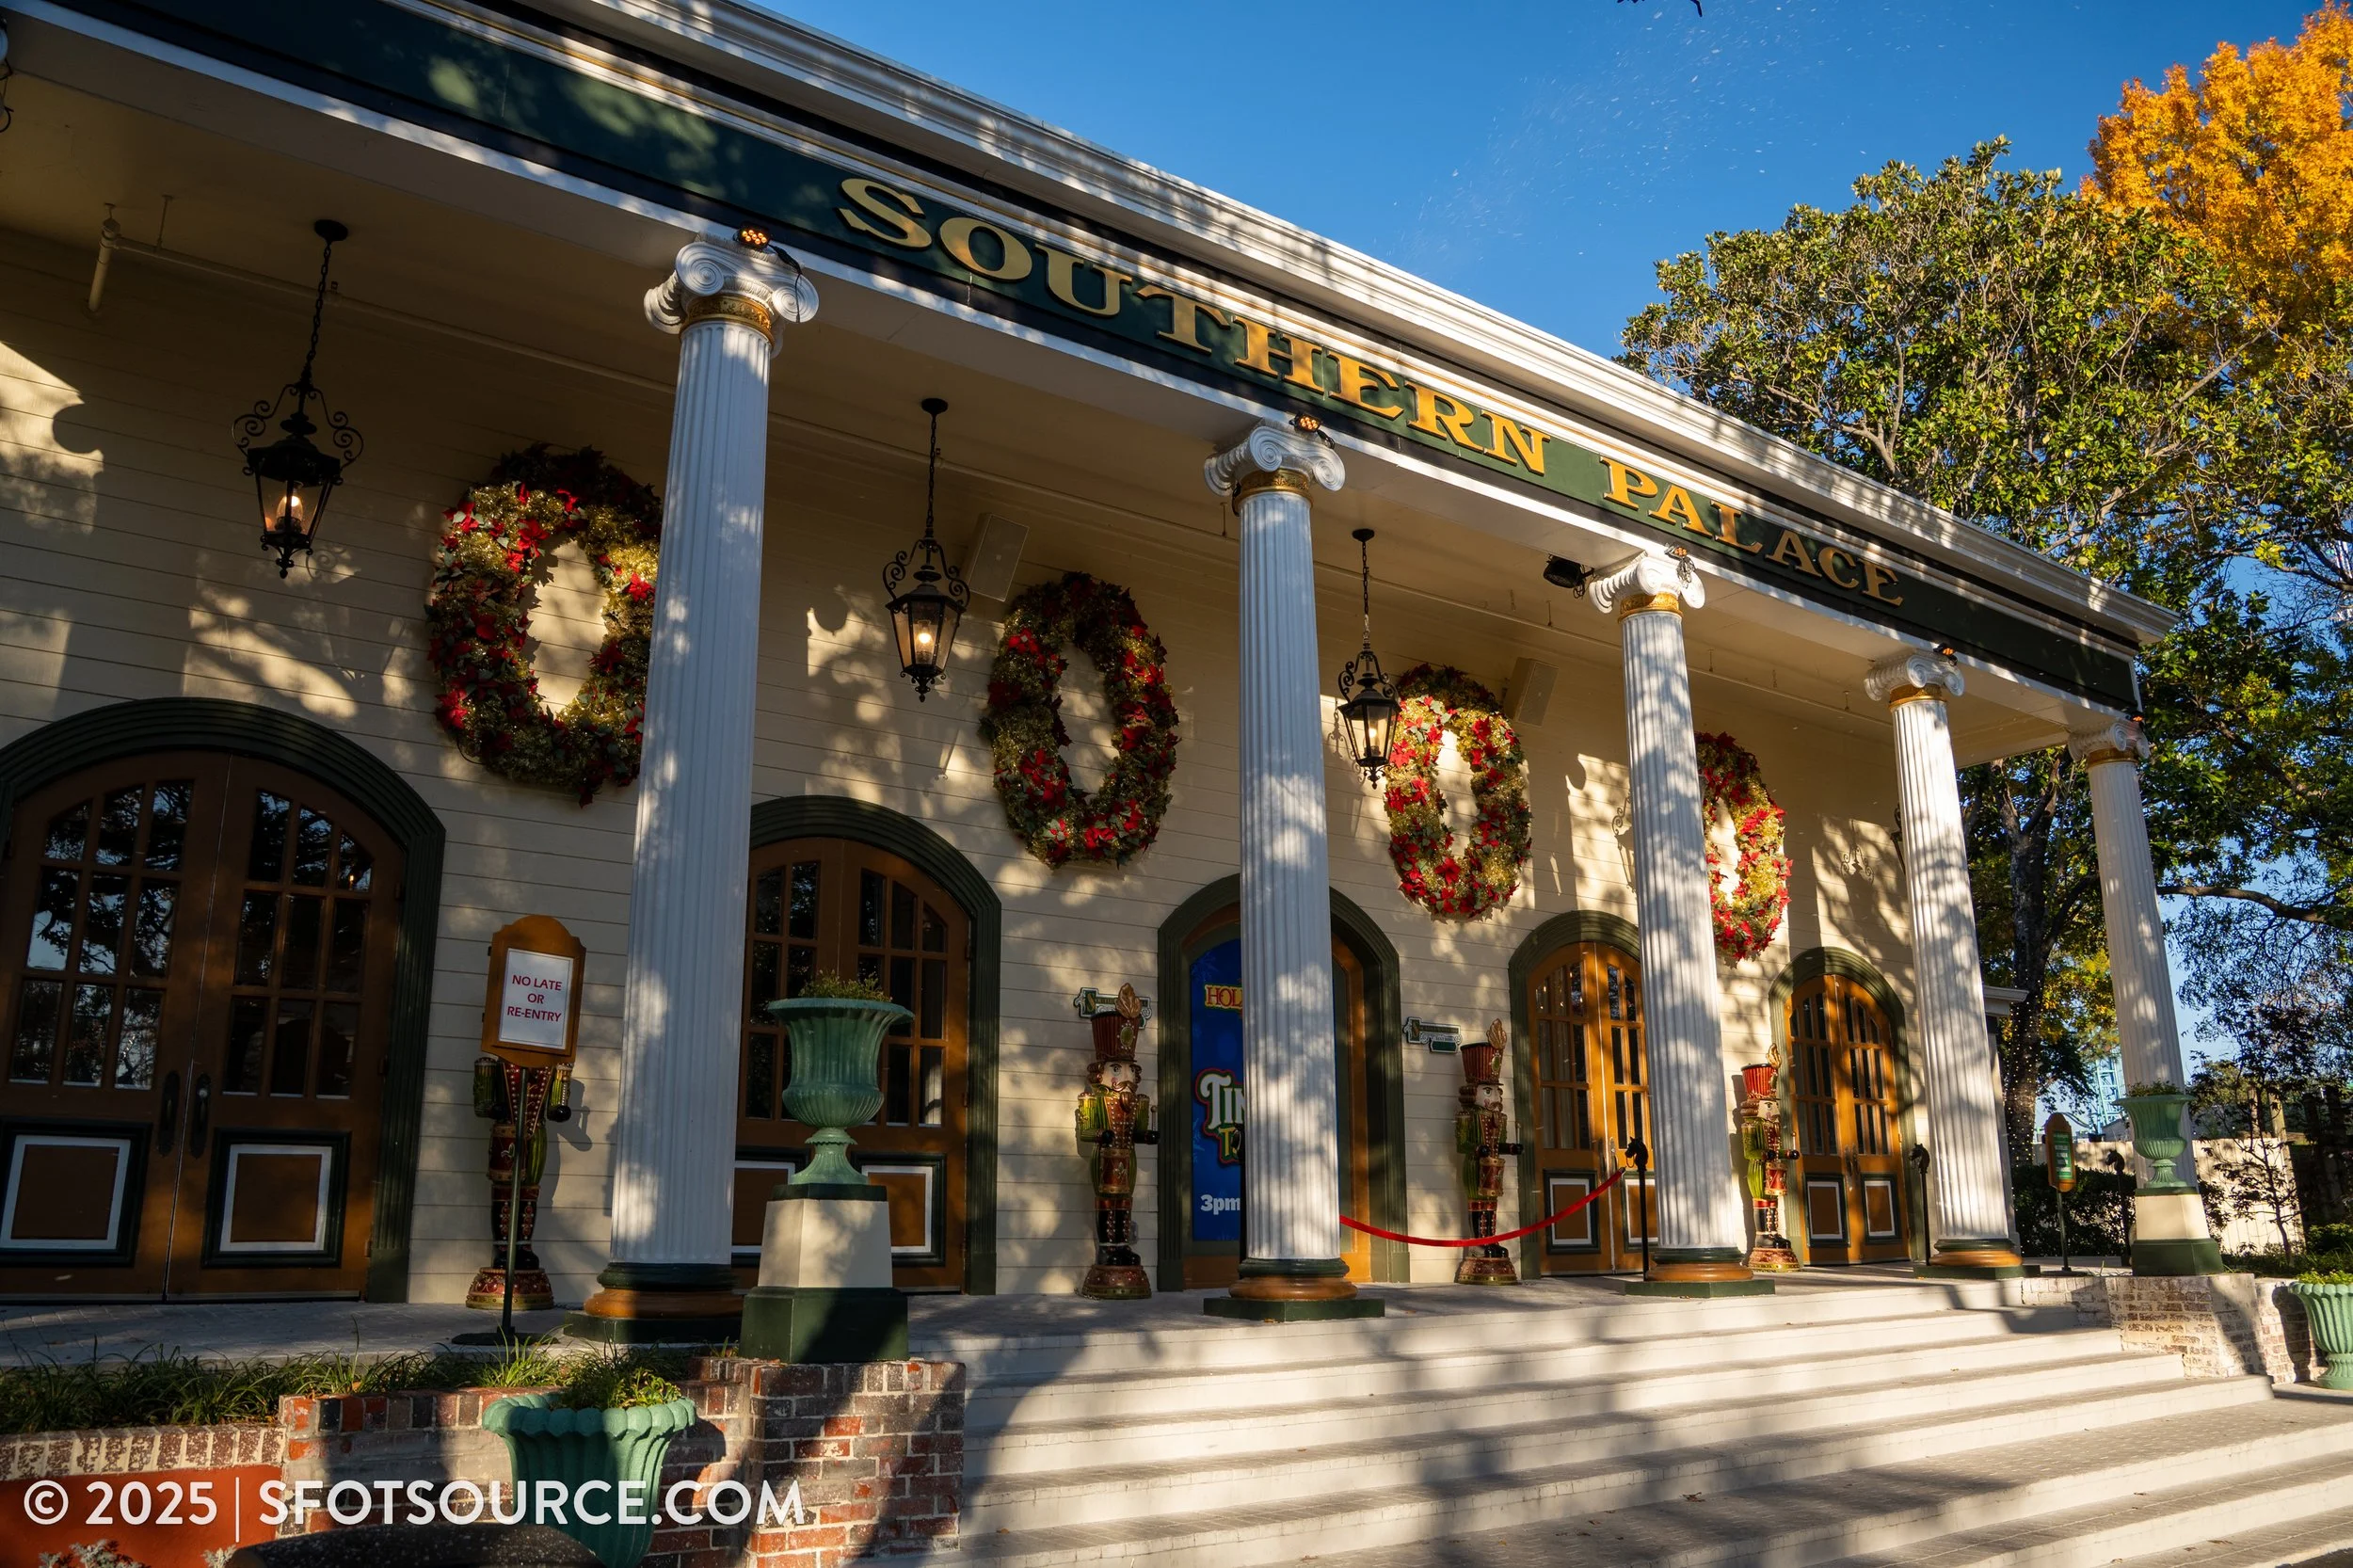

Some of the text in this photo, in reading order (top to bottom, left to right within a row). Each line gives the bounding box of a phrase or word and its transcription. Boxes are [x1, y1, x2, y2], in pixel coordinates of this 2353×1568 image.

[838, 178, 1904, 607] SOUTHERN PALACE
[512, 974, 563, 991] NO LATE
[527, 993, 544, 1004] OR
[506, 1006, 562, 1022] RE-ENTRY
[1200, 1194, 1241, 1215] 3pm
